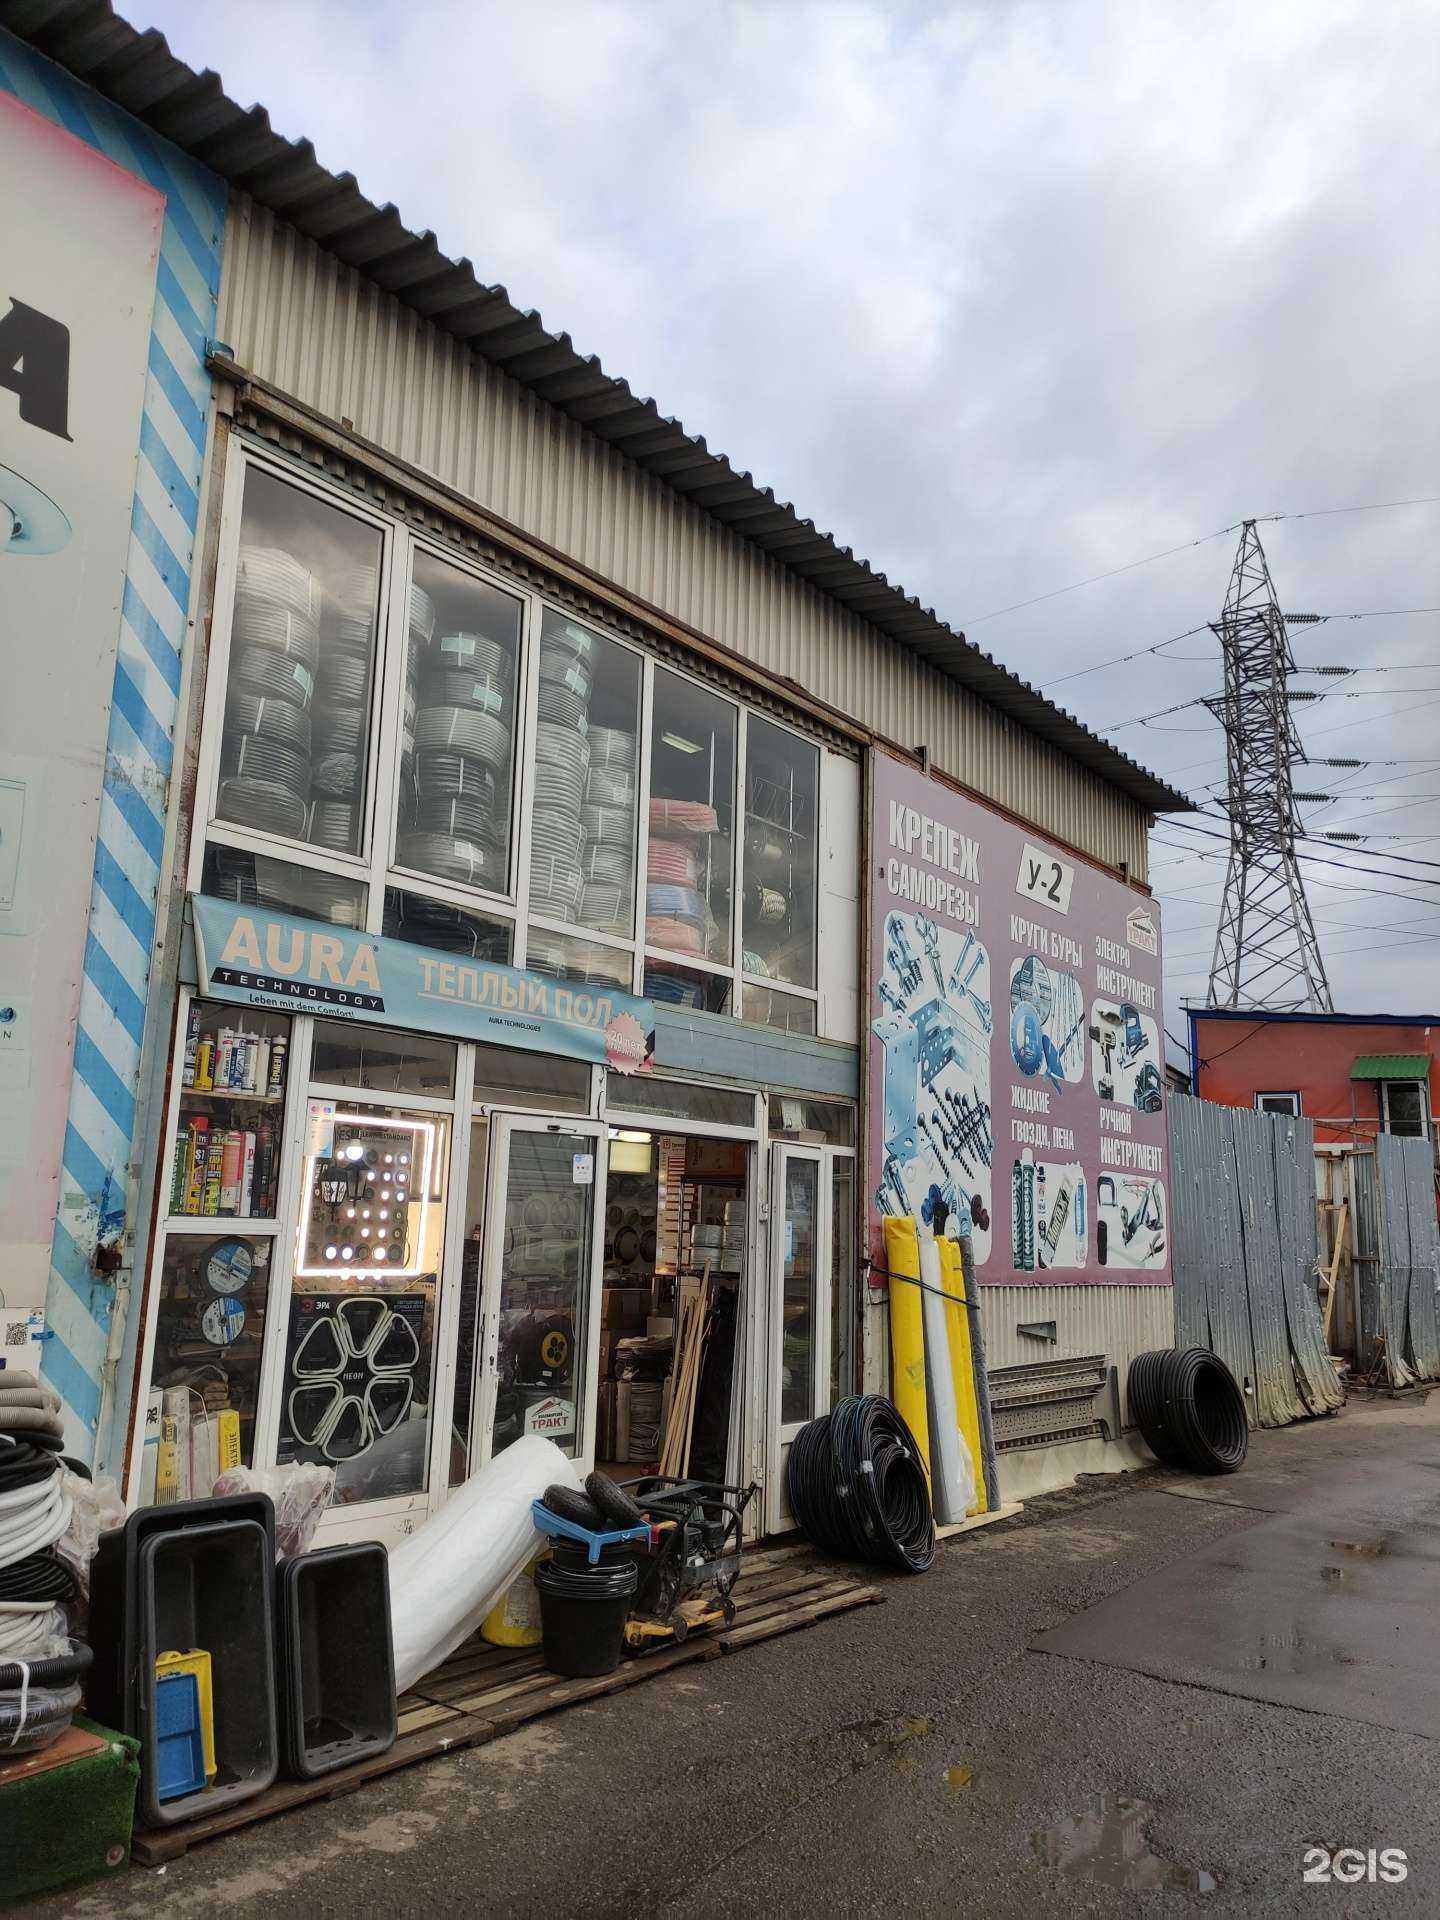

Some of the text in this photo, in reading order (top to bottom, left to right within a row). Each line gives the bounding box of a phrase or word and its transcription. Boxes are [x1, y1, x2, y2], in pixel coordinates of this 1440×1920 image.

[889, 800, 980, 884] КРЕПЕЖ
[887, 858, 980, 928] САМОРЕЗЫ
[1027, 859, 1061, 903] У-2
[220, 916, 383, 991] AURA
[1010, 914, 1083, 969] КРУГИ БУРЫ
[1096, 935, 1130, 968] ЭЛЕКТРО
[222, 971, 378, 1008] TECHNOLOGY
[417, 956, 612, 1030] ТЕПЛЫЙ ПОЛ
[1096, 964, 1156, 1009] ИНСТРУМЕНТ
[249, 994, 355, 1019] Leben mit dem Comfort!
[488, 1016, 541, 1032] AURA TECHNOLOGIES
[607, 1030, 640, 1050] 20 лет
[1011, 1085, 1050, 1113] ЖИДКИЕ
[1011, 1119, 1075, 1150] ГВОЗДИ, ПЕНА
[1100, 1107, 1132, 1134] РУЧНОЙ
[1100, 1136, 1163, 1173] ИНСТРУМЕНТ
[315, 1301, 330, 1310] ЭРА
[342, 1371, 364, 1381] НЕОН
[531, 1416, 568, 1430] ТРАКТ
